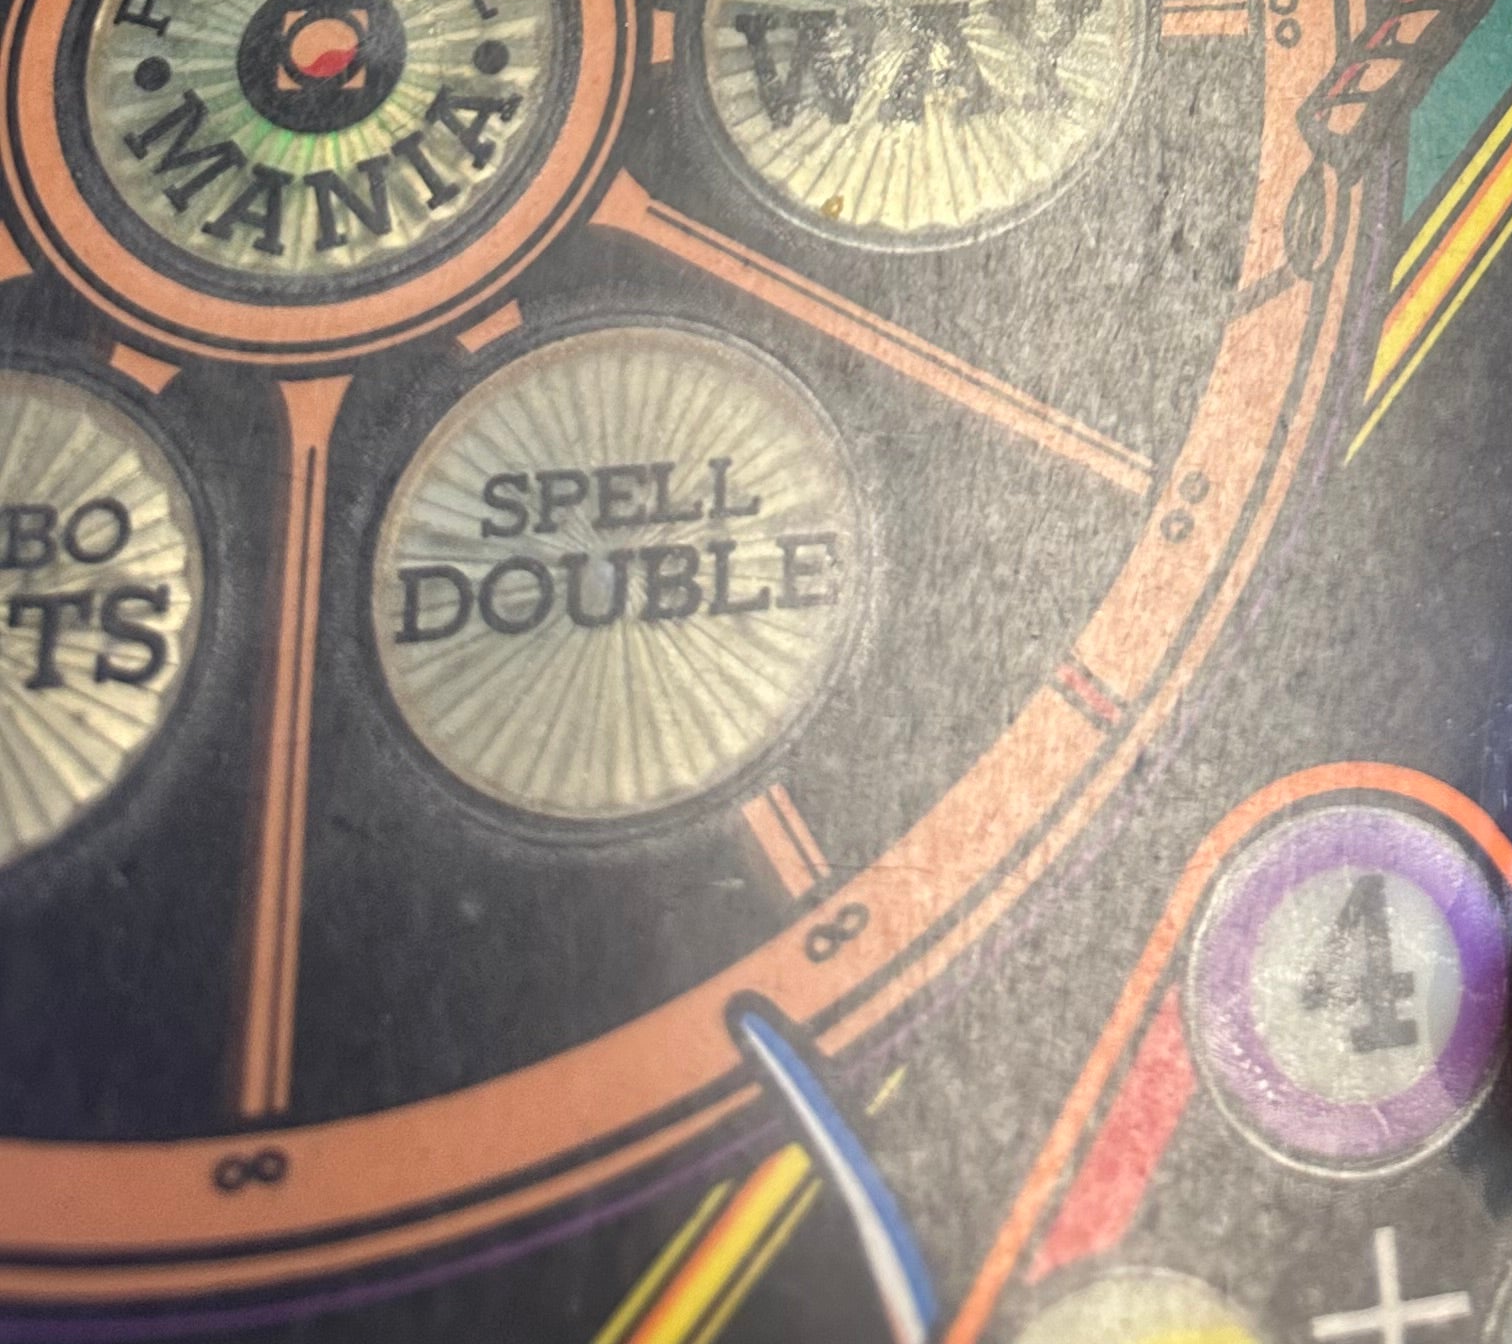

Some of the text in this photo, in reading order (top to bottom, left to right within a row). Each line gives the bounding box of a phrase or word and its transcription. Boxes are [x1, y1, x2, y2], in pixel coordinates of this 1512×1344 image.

[122, 85, 525, 256] MANIA
[481, 457, 762, 539] SPELL
[394, 532, 840, 644] DOUBLE
[1302, 872, 1424, 1053] 4
